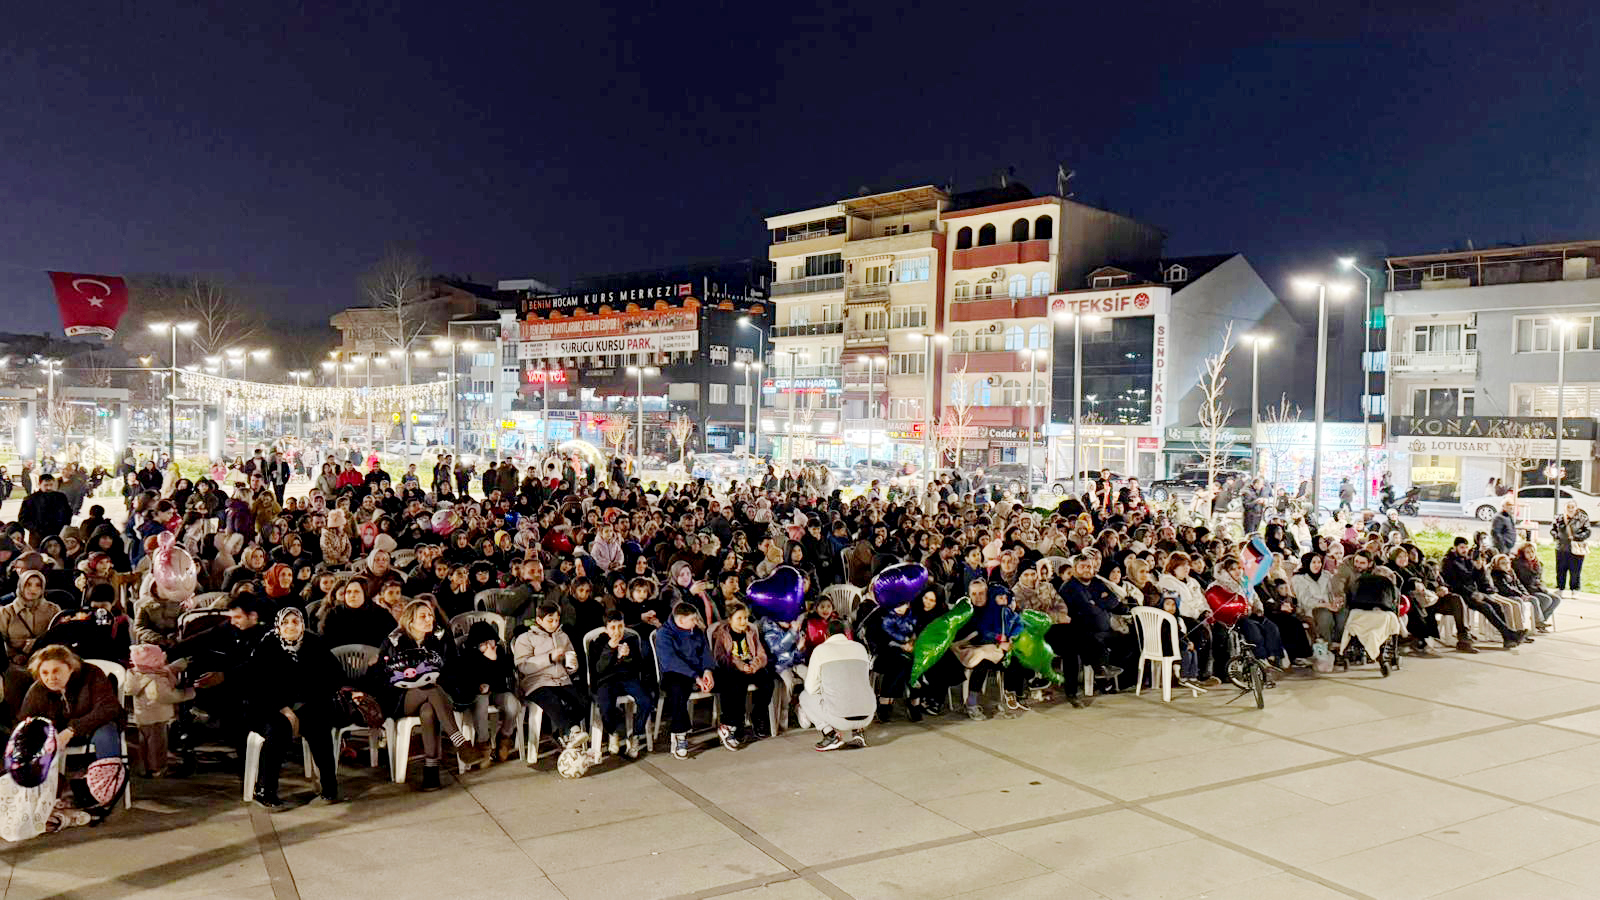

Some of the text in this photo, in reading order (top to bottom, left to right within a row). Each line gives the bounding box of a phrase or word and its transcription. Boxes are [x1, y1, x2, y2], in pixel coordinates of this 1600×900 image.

[552, 295, 578, 308] HOCAM
[584, 291, 614, 305] KURS
[1067, 293, 1131, 313] TEKSİF
[596, 339, 625, 352] KURSU
[627, 337, 651, 350] PARK
[775, 379, 806, 388] CEYAN
[808, 378, 837, 388] HARİTA
[1155, 326, 1165, 425] SENDİKASI
[989, 428, 1017, 439] Cadde
[1432, 441, 1491, 452] LOTUSART
